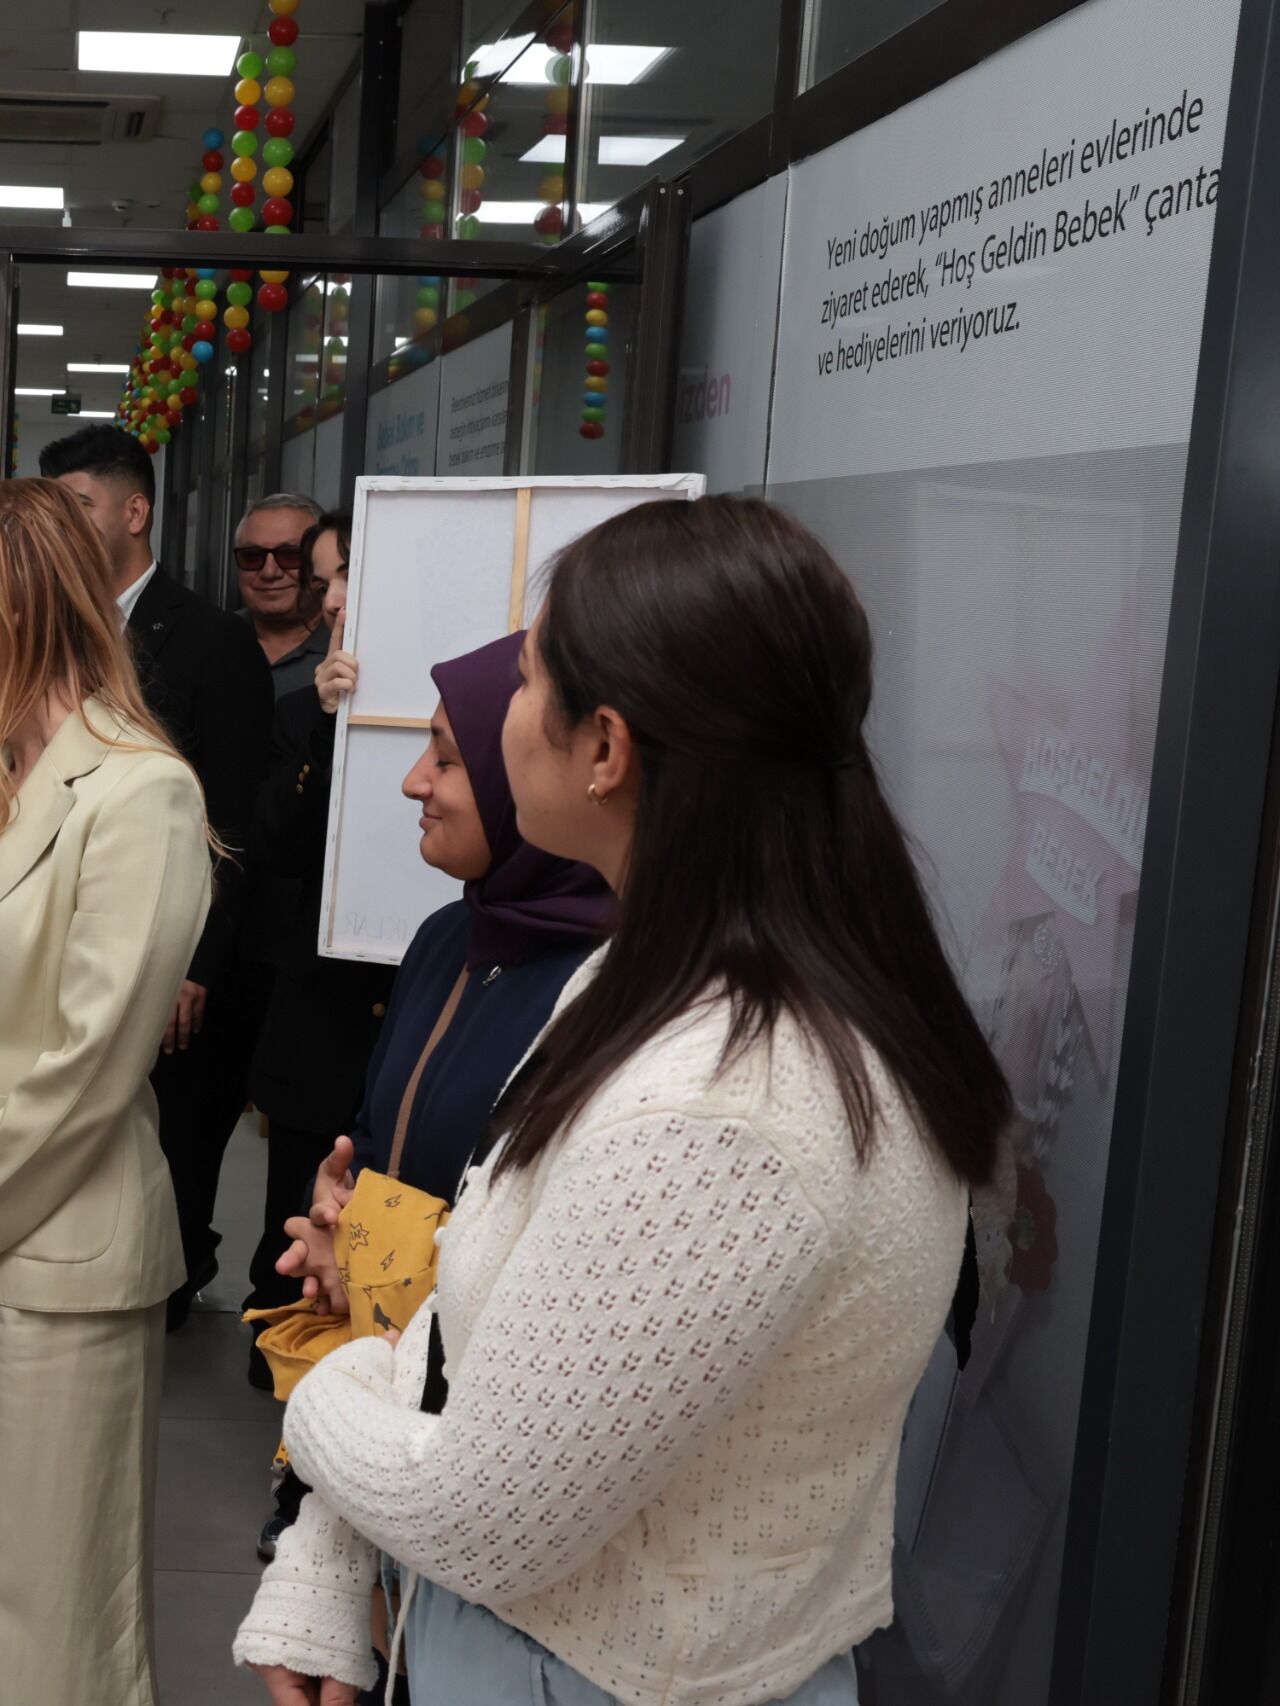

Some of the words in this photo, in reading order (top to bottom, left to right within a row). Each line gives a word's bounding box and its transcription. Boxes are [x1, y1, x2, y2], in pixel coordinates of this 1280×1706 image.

[826, 230, 858, 270] Yeni
[859, 212, 916, 260] doğum
[919, 184, 984, 246] yapmış
[987, 138, 1076, 210] anneleri
[1080, 88, 1204, 174] evlerinde
[821, 282, 868, 330] ziyaret
[871, 258, 930, 308] ederek,
[980, 218, 1046, 275] Geldin
[818, 347, 833, 376] ve
[836, 316, 926, 375] hediyelerini
[929, 300, 1021, 352] veriyoruz.
